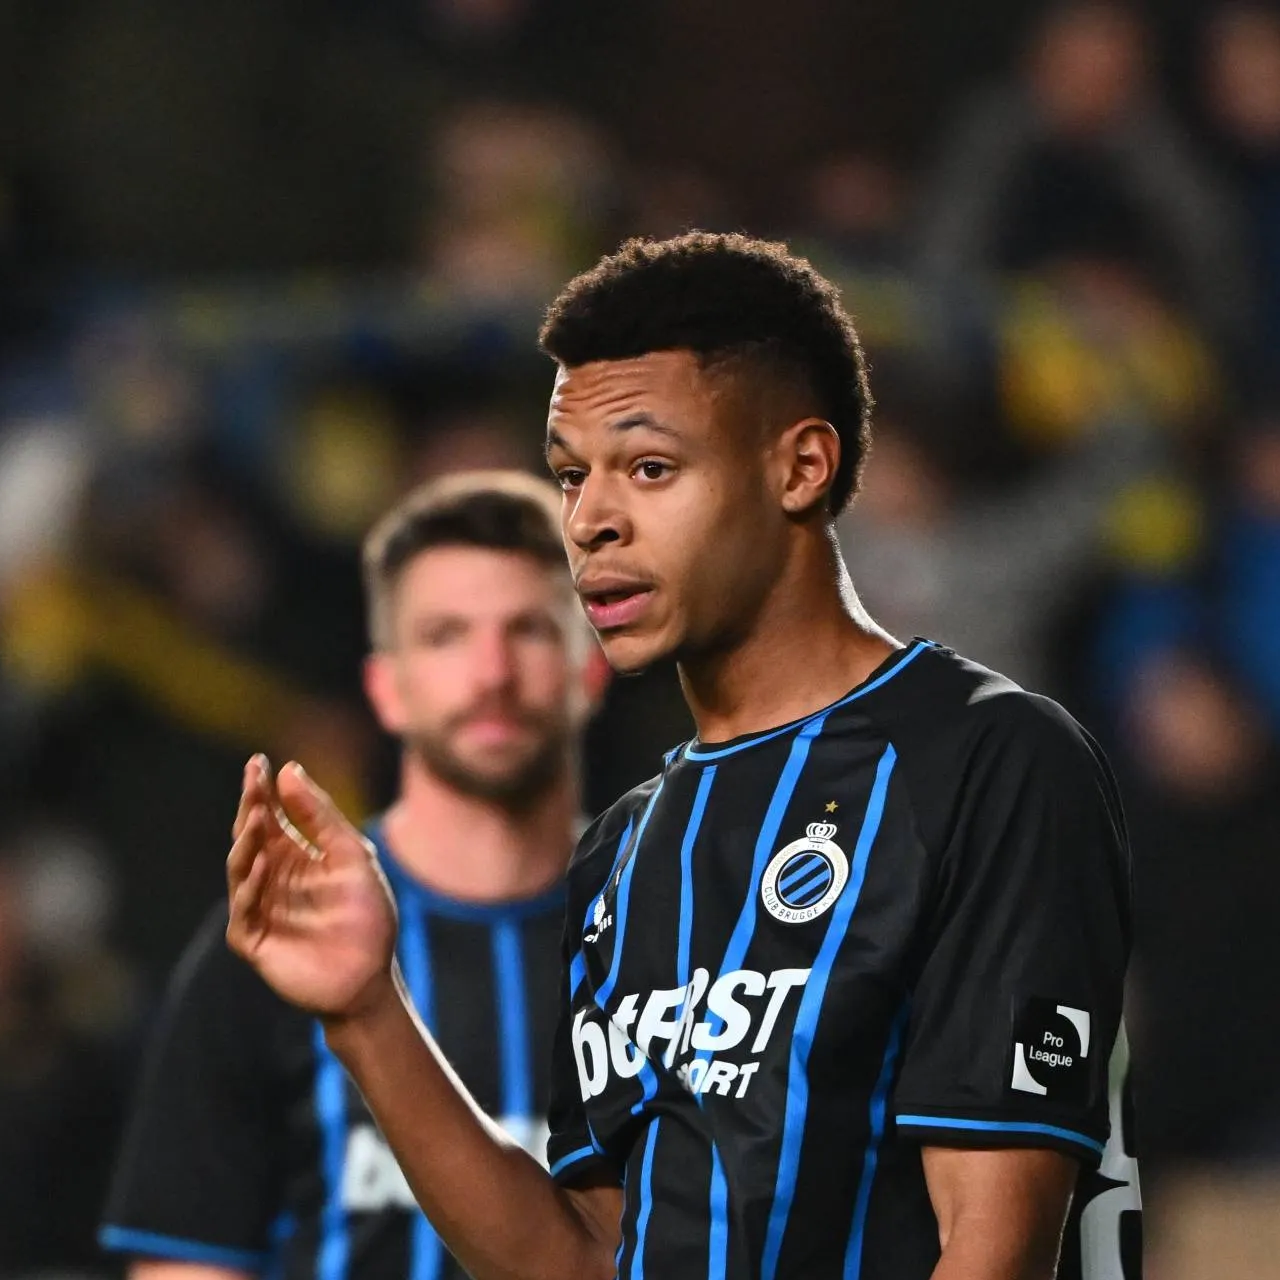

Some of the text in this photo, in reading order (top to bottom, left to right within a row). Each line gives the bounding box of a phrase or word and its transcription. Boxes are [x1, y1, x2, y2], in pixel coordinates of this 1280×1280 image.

[764, 885, 779, 912] CLUB
[778, 907, 819, 921] BRUGGE
[1042, 1031, 1064, 1048] Pro
[1029, 1045, 1073, 1067] League
